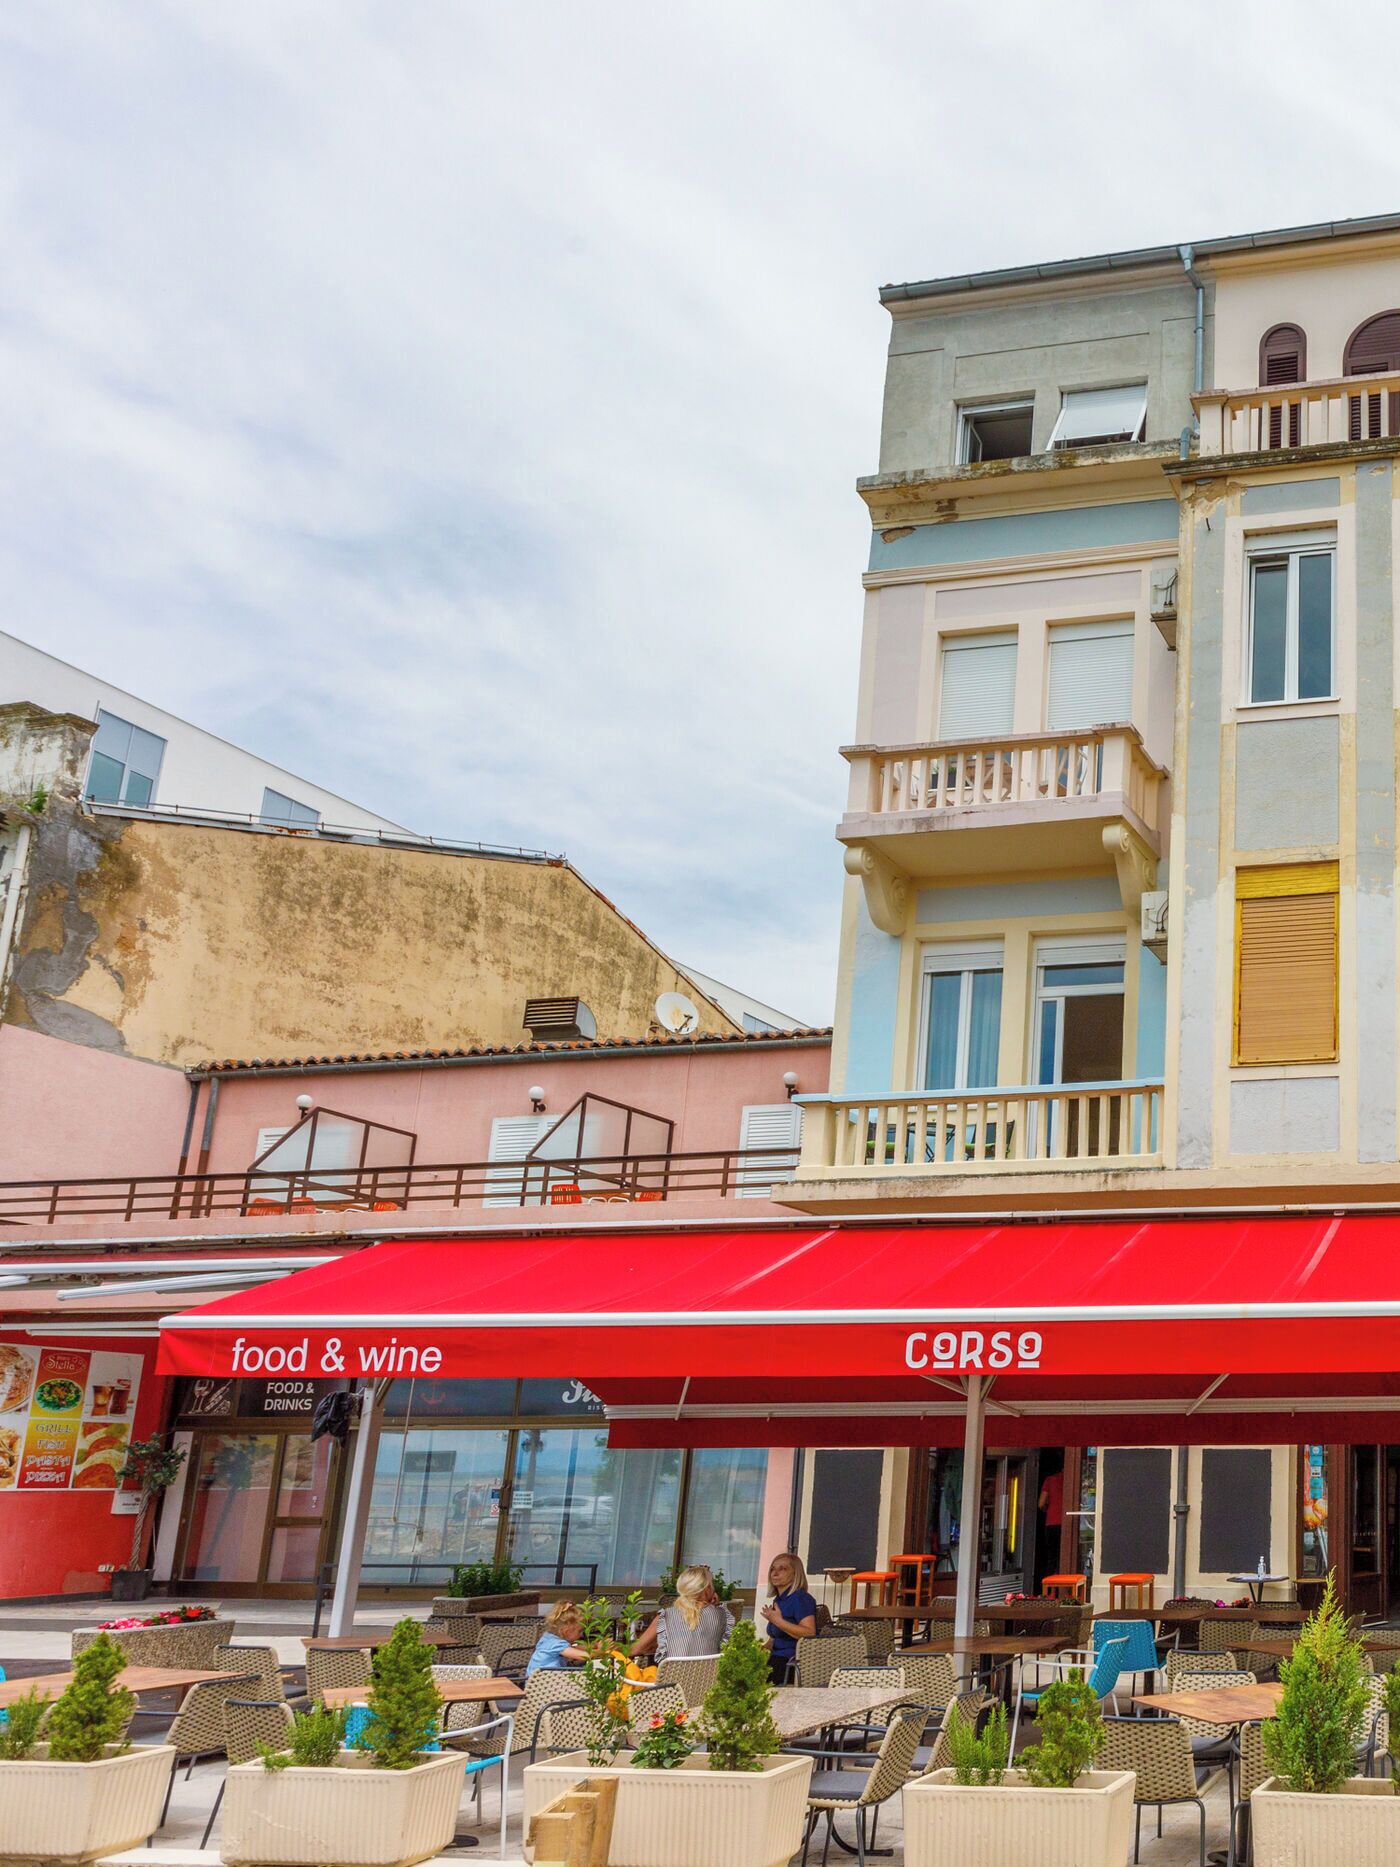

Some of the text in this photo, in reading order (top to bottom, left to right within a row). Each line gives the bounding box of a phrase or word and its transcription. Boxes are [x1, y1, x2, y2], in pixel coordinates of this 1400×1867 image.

[231, 1338, 443, 1372] food & wine
[905, 1331, 1042, 1369] CORSO
[266, 1382, 315, 1394] FOOD &
[264, 1398, 313, 1411] DRINKS
